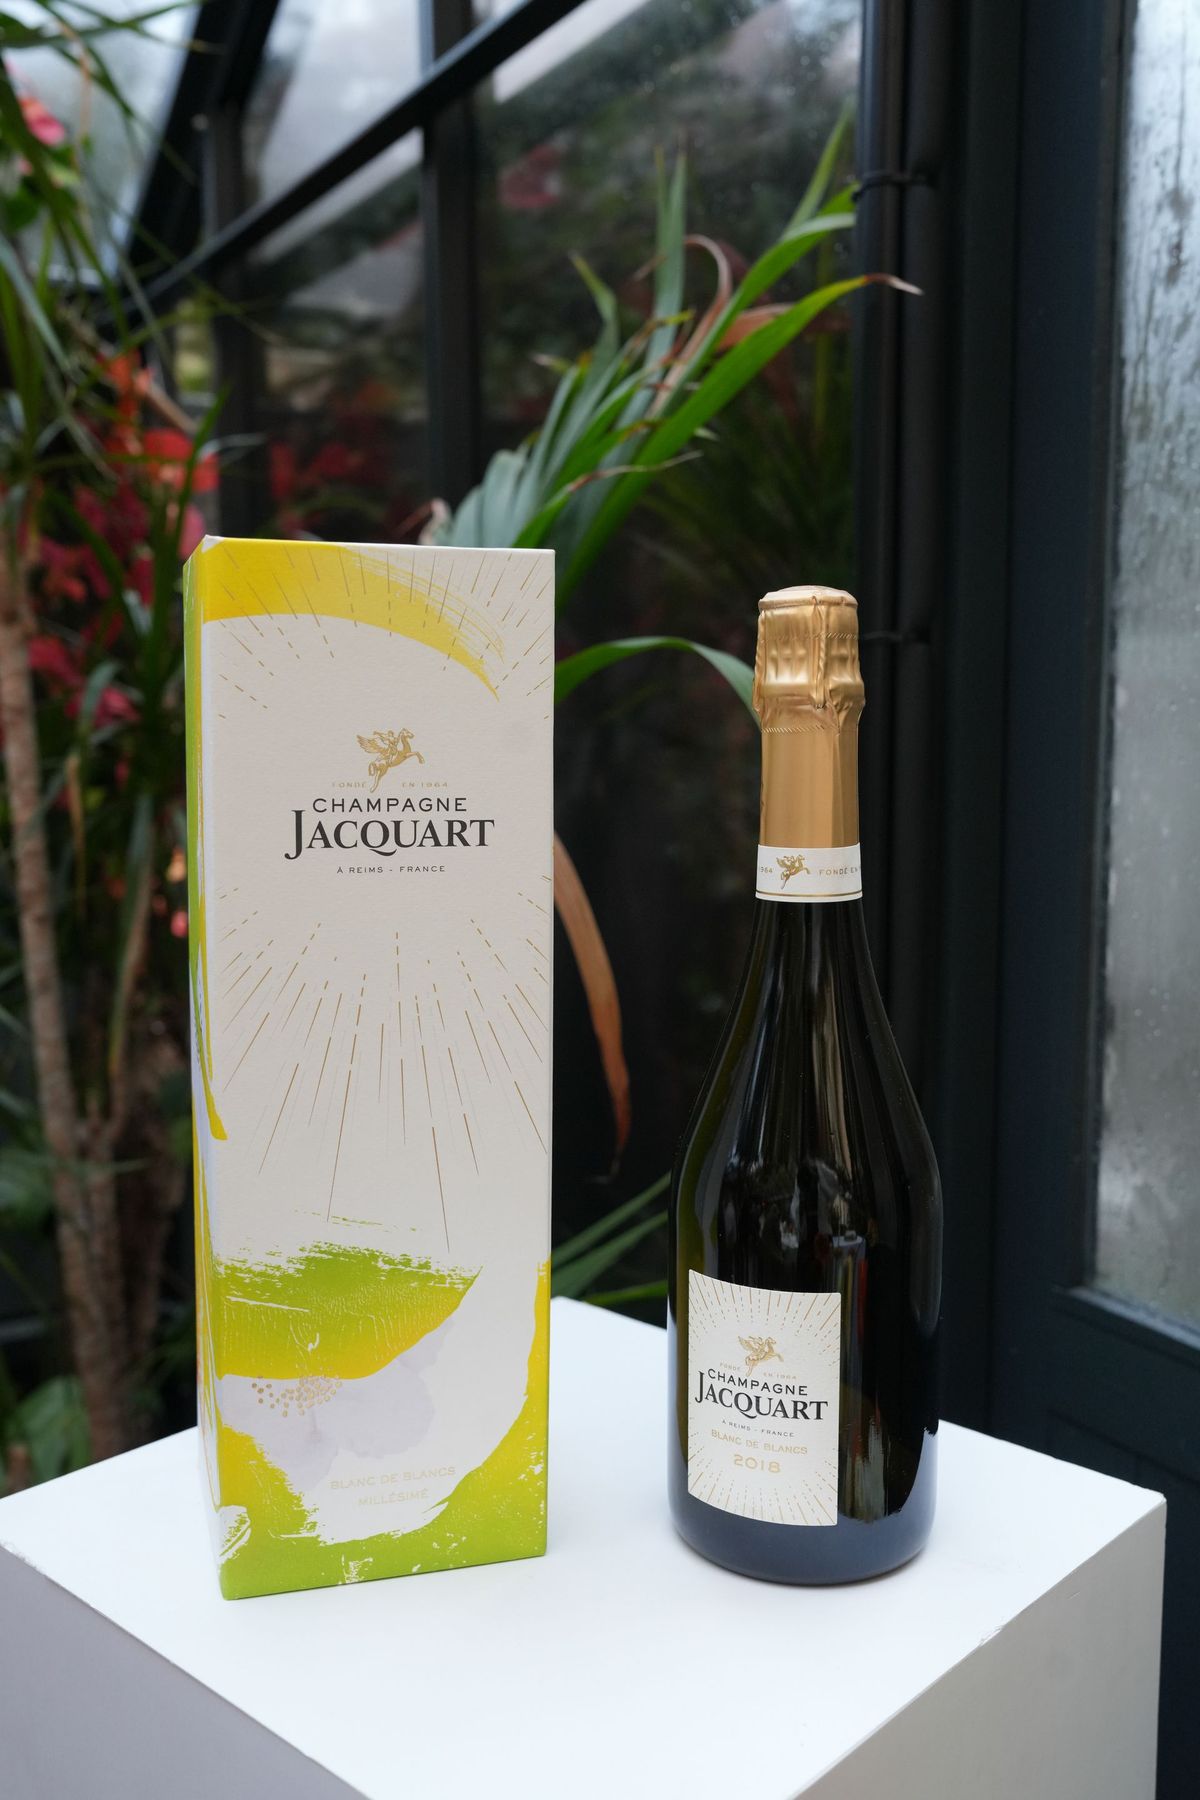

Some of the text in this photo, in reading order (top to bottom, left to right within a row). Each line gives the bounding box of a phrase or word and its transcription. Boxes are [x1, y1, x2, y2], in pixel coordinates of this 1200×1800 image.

[312, 797, 467, 813] CHAMPAGNE
[284, 809, 495, 860] JACQUART
[349, 866, 384, 874] REIMS
[399, 865, 446, 873] FRANCE
[707, 1368, 808, 1396] CHAMPAGNE
[694, 1371, 829, 1420] JACQUART
[728, 1421, 751, 1431] REIMS
[761, 1429, 795, 1438] FRANCE
[711, 1429, 808, 1455] BLANC DE BLANCS
[733, 1453, 781, 1473] 2018
[330, 1466, 456, 1490] BLANC DE BLANCS
[358, 1487, 430, 1505] MILLÉSIMÉ
